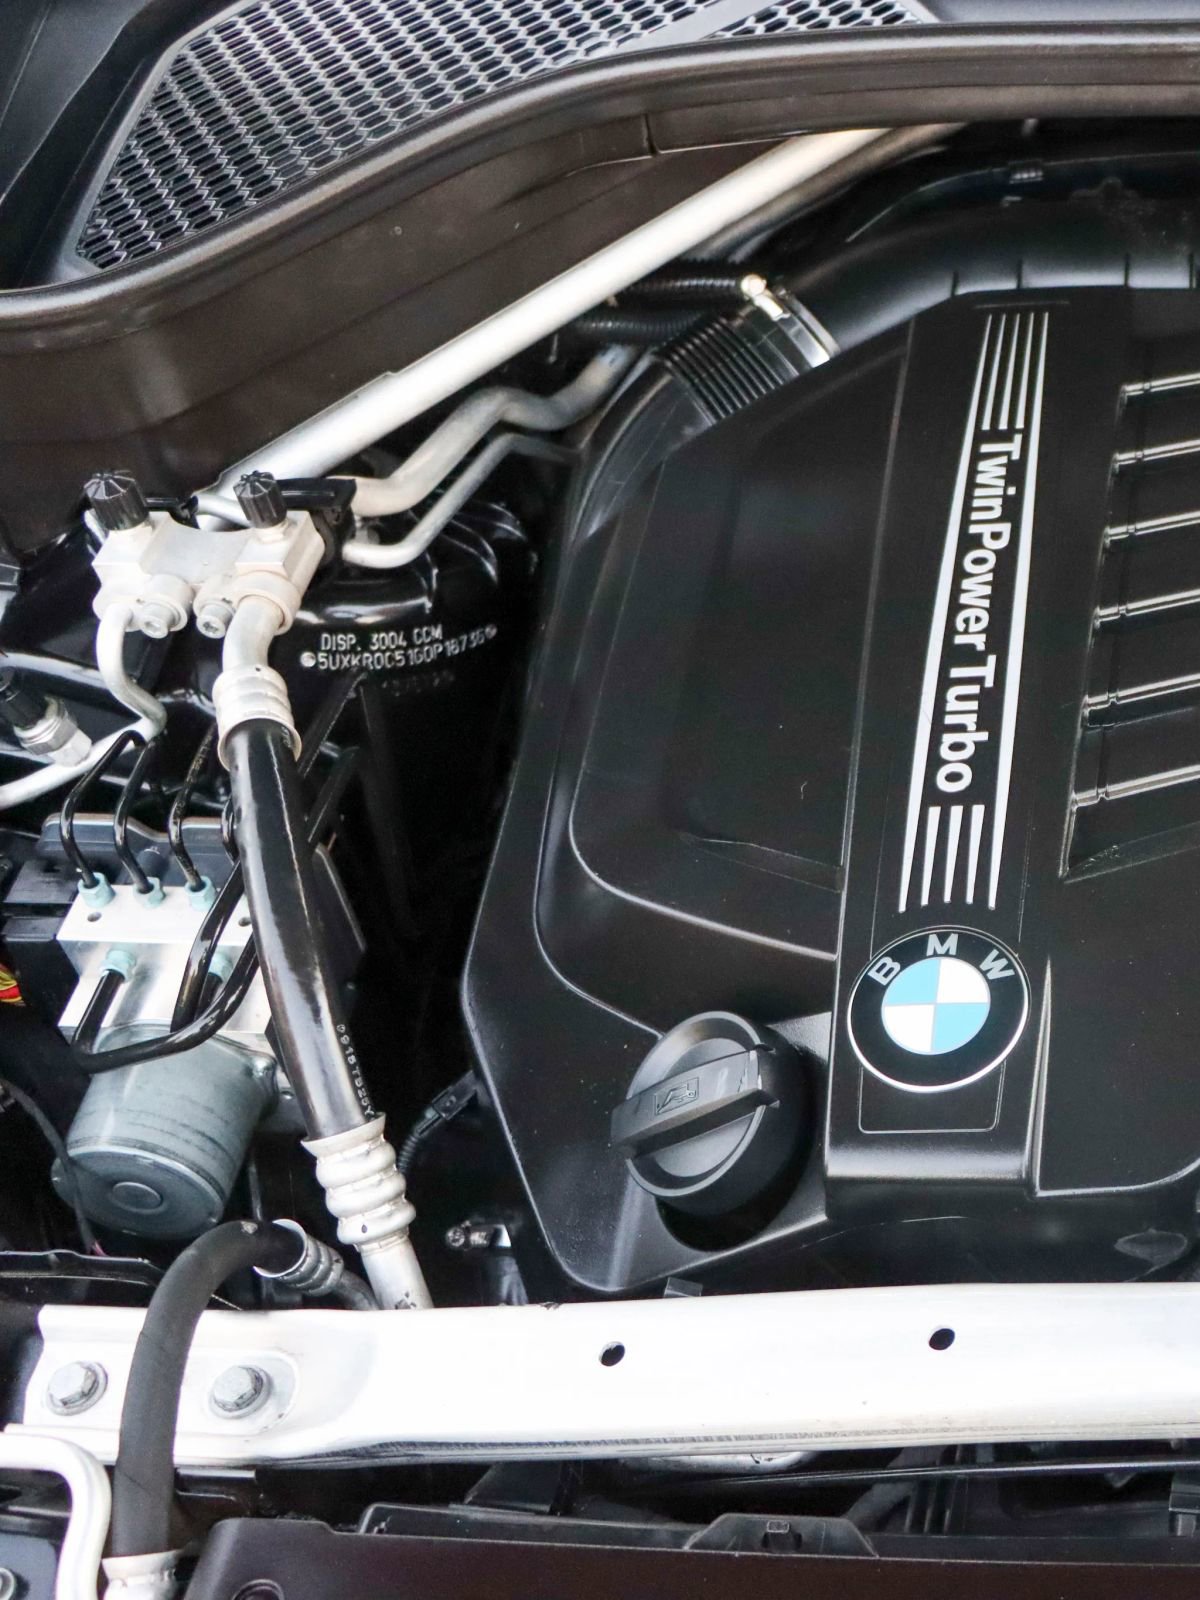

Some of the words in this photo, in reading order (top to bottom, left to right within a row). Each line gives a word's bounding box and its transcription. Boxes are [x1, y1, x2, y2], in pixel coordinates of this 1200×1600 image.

[954, 434, 1022, 650] TwinPower
[321, 633, 362, 651] DISP.
[370, 631, 407, 650] 3004
[413, 623, 443, 645] CCM
[936, 654, 996, 793] Turbo
[867, 933, 1015, 986] BMW
